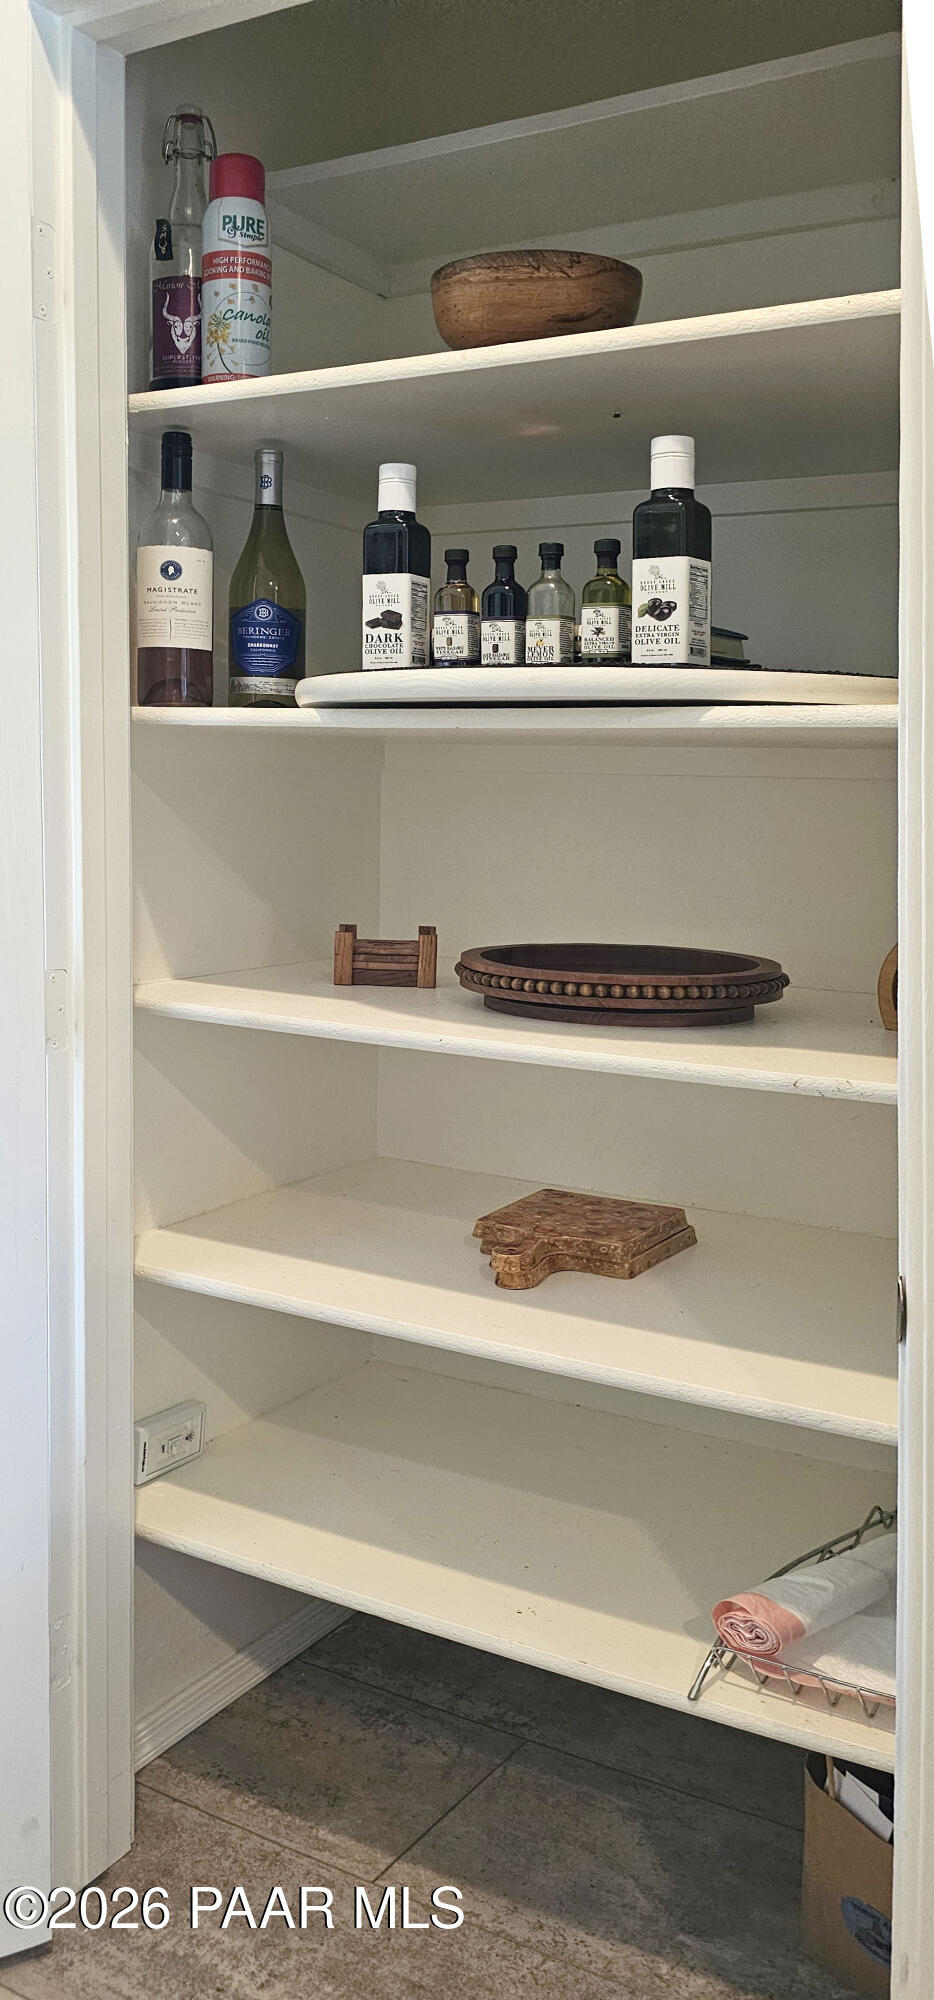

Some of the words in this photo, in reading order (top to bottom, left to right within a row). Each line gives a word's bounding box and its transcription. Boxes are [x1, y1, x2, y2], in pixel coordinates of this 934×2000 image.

[222, 215, 265, 236] PURE
[213, 256, 229, 264] HIGH
[229, 265, 245, 273] AND
[223, 308, 271, 327] canola
[255, 328, 270, 342] oil
[146, 586, 198, 595] MAGISTRATE
[237, 626, 291, 637] BERINGER
[635, 624, 680, 633] DELICATE
[365, 633, 403, 643] DARK
[527, 645, 554, 653] MEYER
